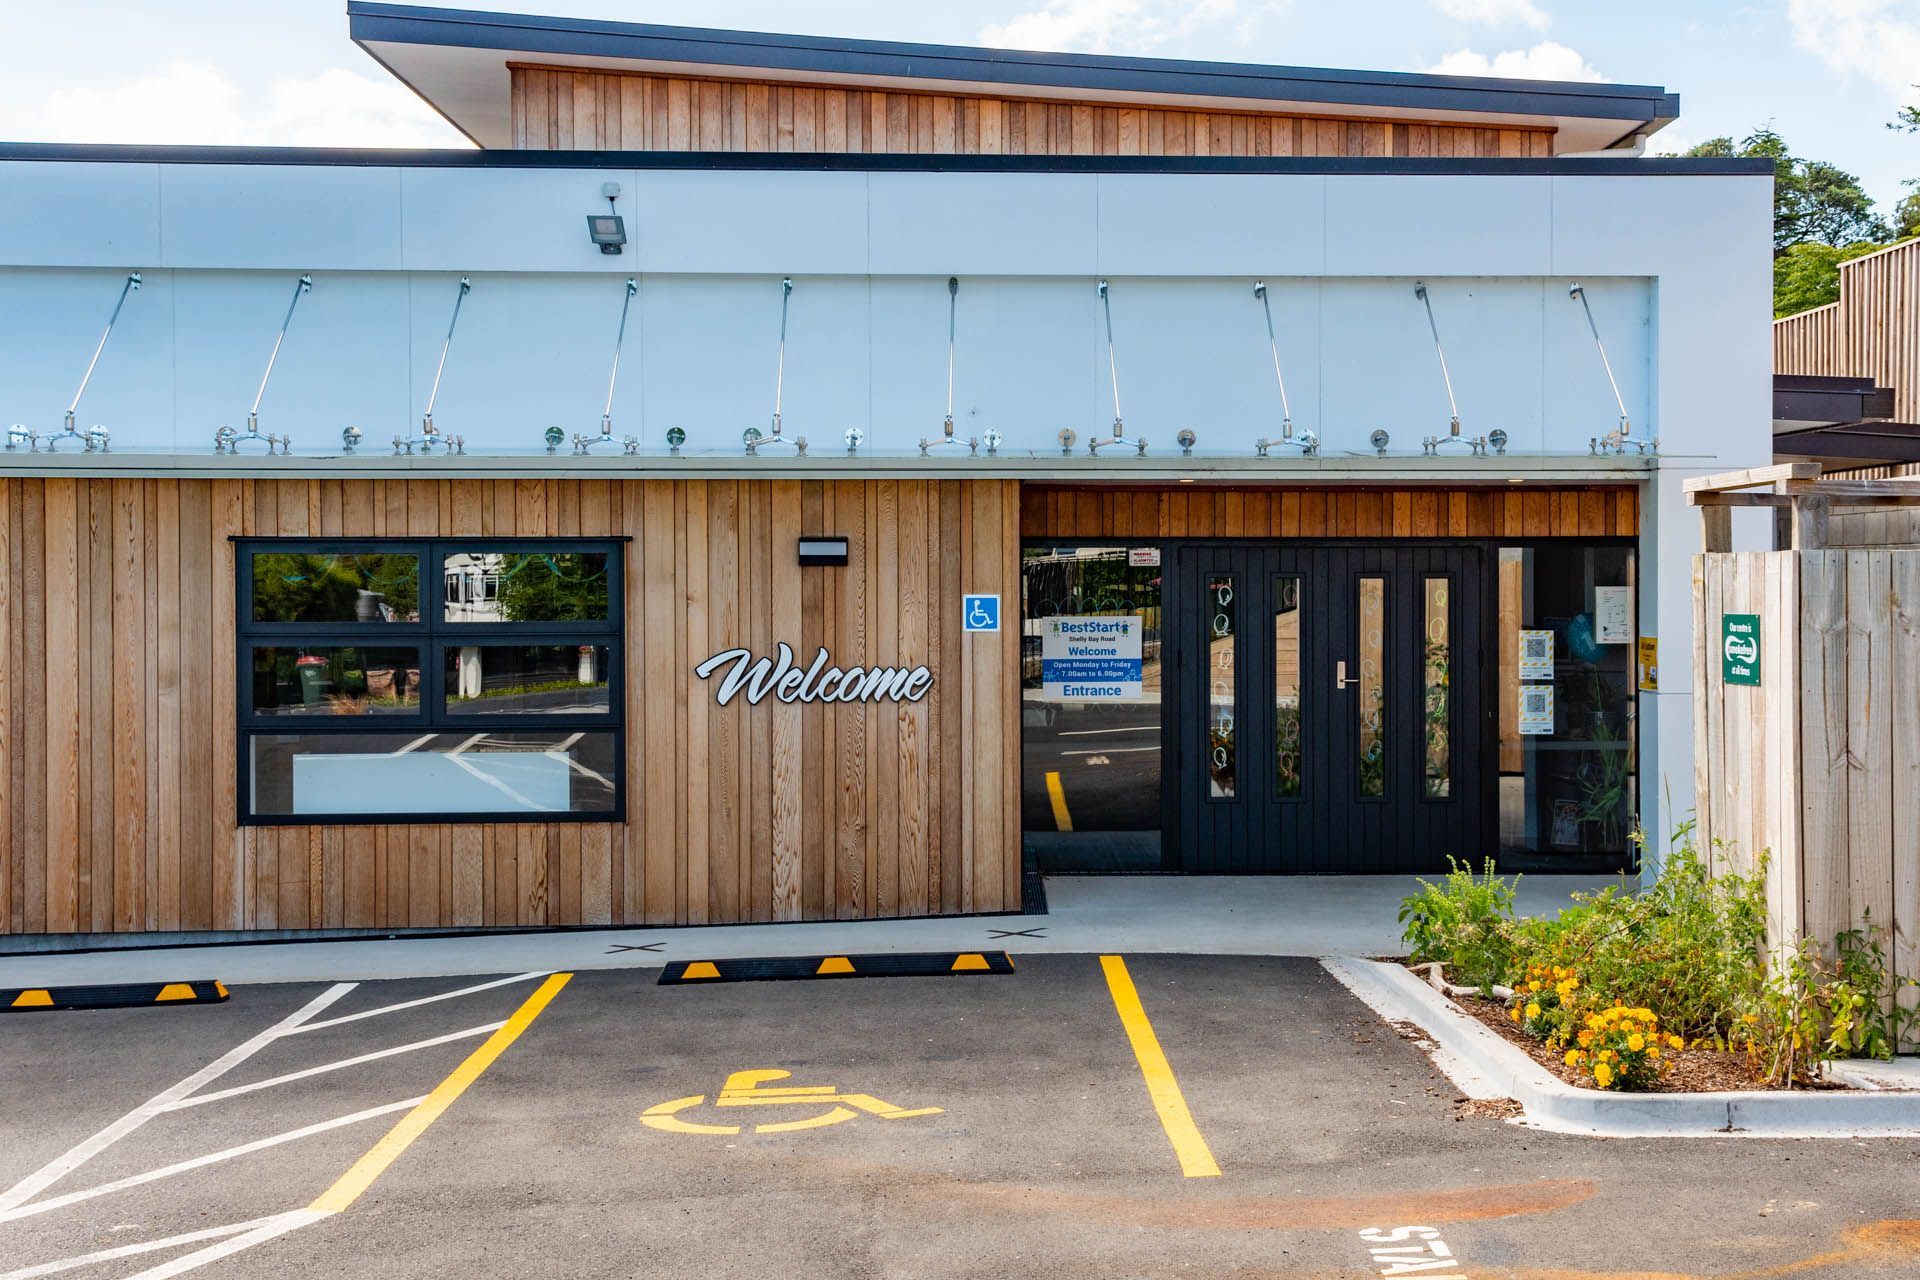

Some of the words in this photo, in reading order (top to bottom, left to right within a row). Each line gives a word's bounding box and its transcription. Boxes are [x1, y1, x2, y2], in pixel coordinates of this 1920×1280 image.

[1061, 622, 1120, 633] BestStart
[1068, 647, 1117, 656] Welcome
[1072, 661, 1100, 669] Monday
[1110, 661, 1131, 669] Friday
[694, 642, 935, 707] Welcome
[1097, 670, 1124, 678] 6.00pm
[1063, 685, 1122, 696] Entrance
